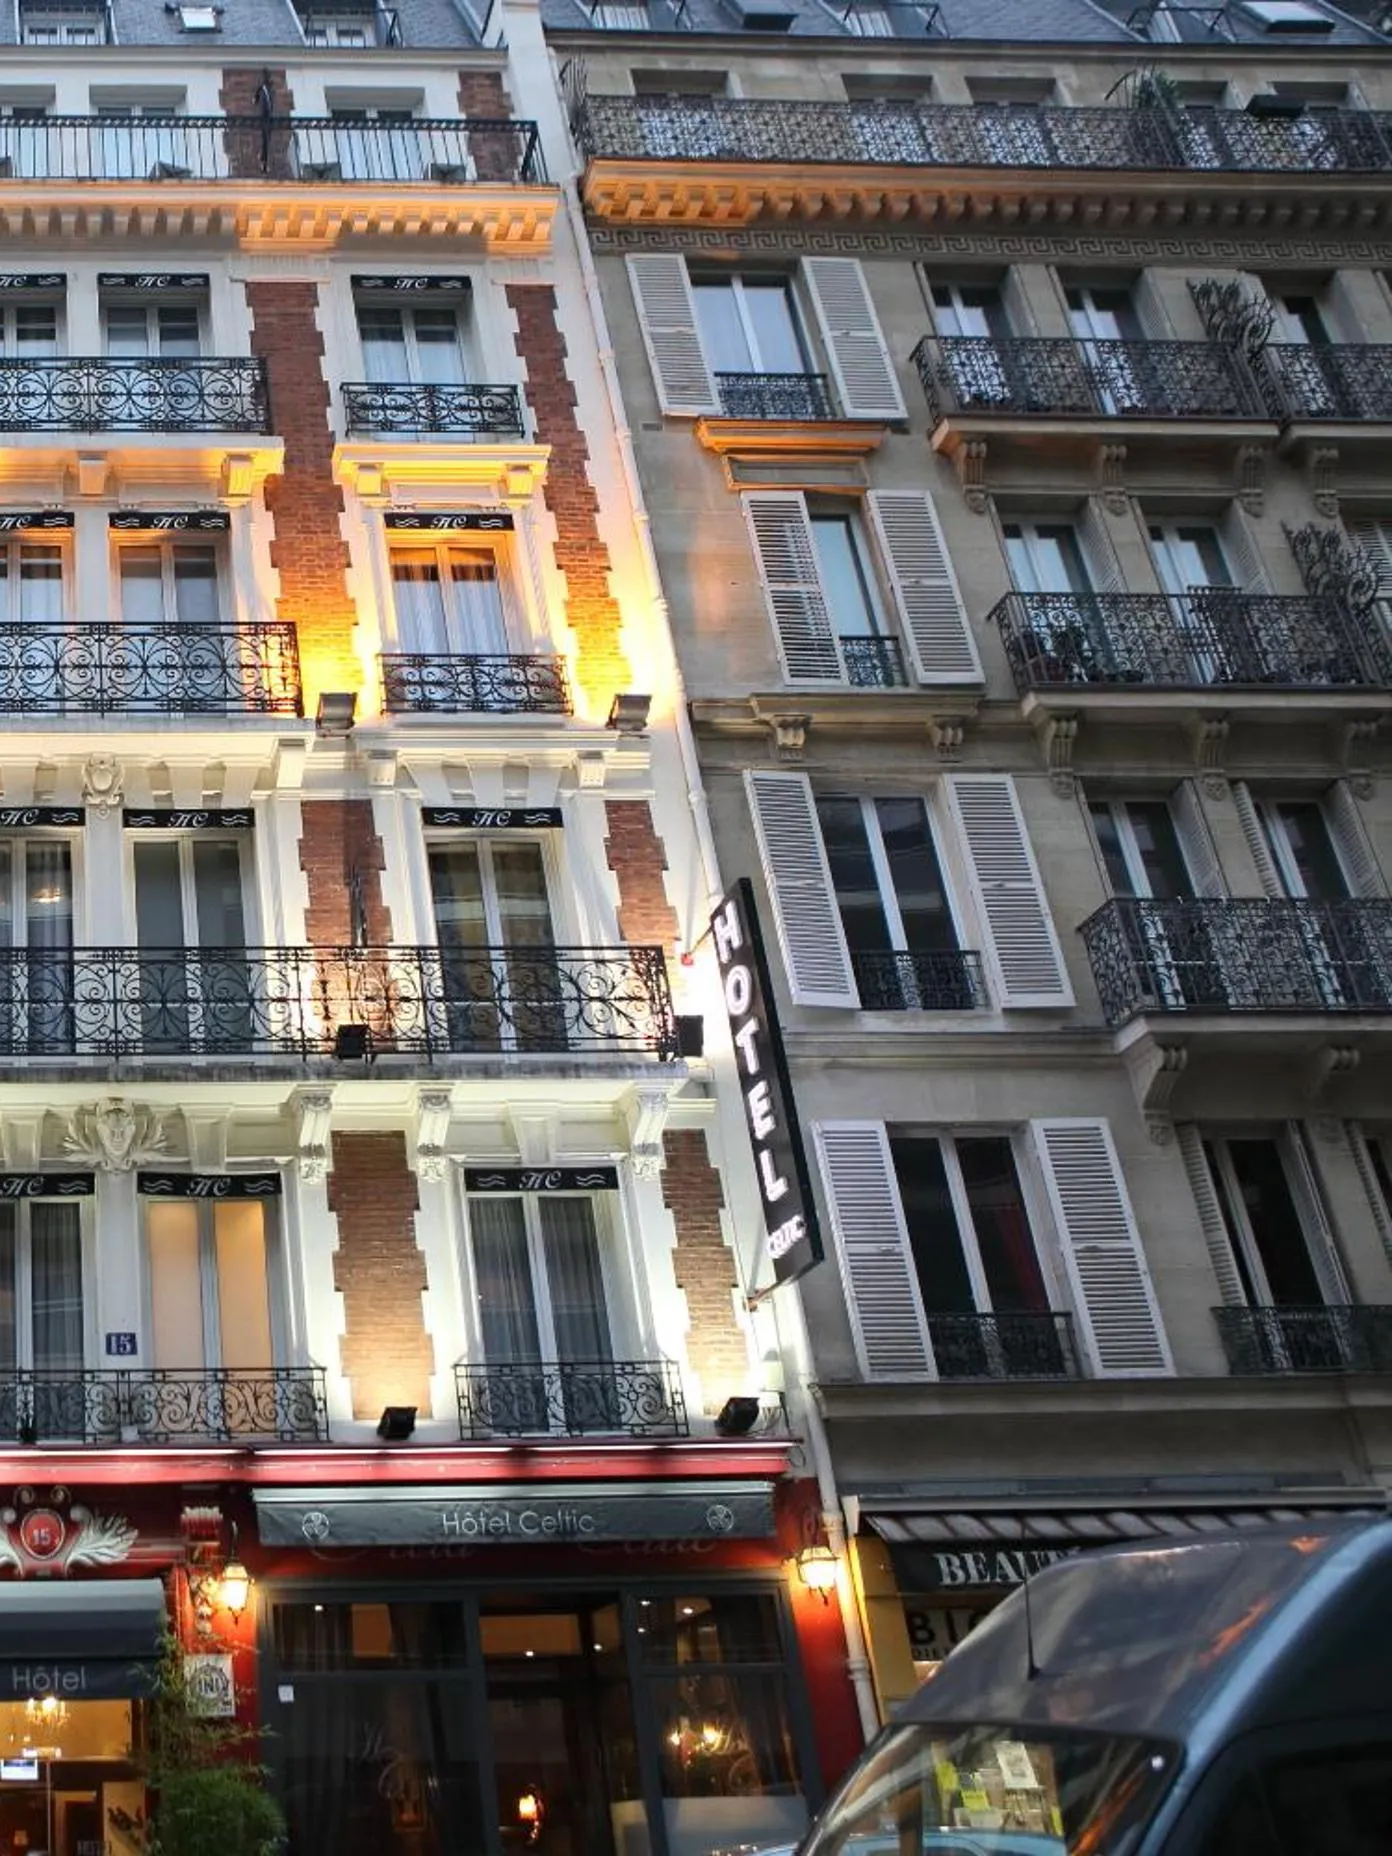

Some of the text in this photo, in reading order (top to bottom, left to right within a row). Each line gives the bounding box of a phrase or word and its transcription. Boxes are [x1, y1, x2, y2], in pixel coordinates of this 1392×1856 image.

[714, 900, 788, 1201] HOTEL
[111, 1335, 131, 1354] 15
[442, 1510, 595, 1537] Hôtel Celtic
[32, 1529, 52, 1545] 15
[12, 1665, 86, 1691] Hôtel
